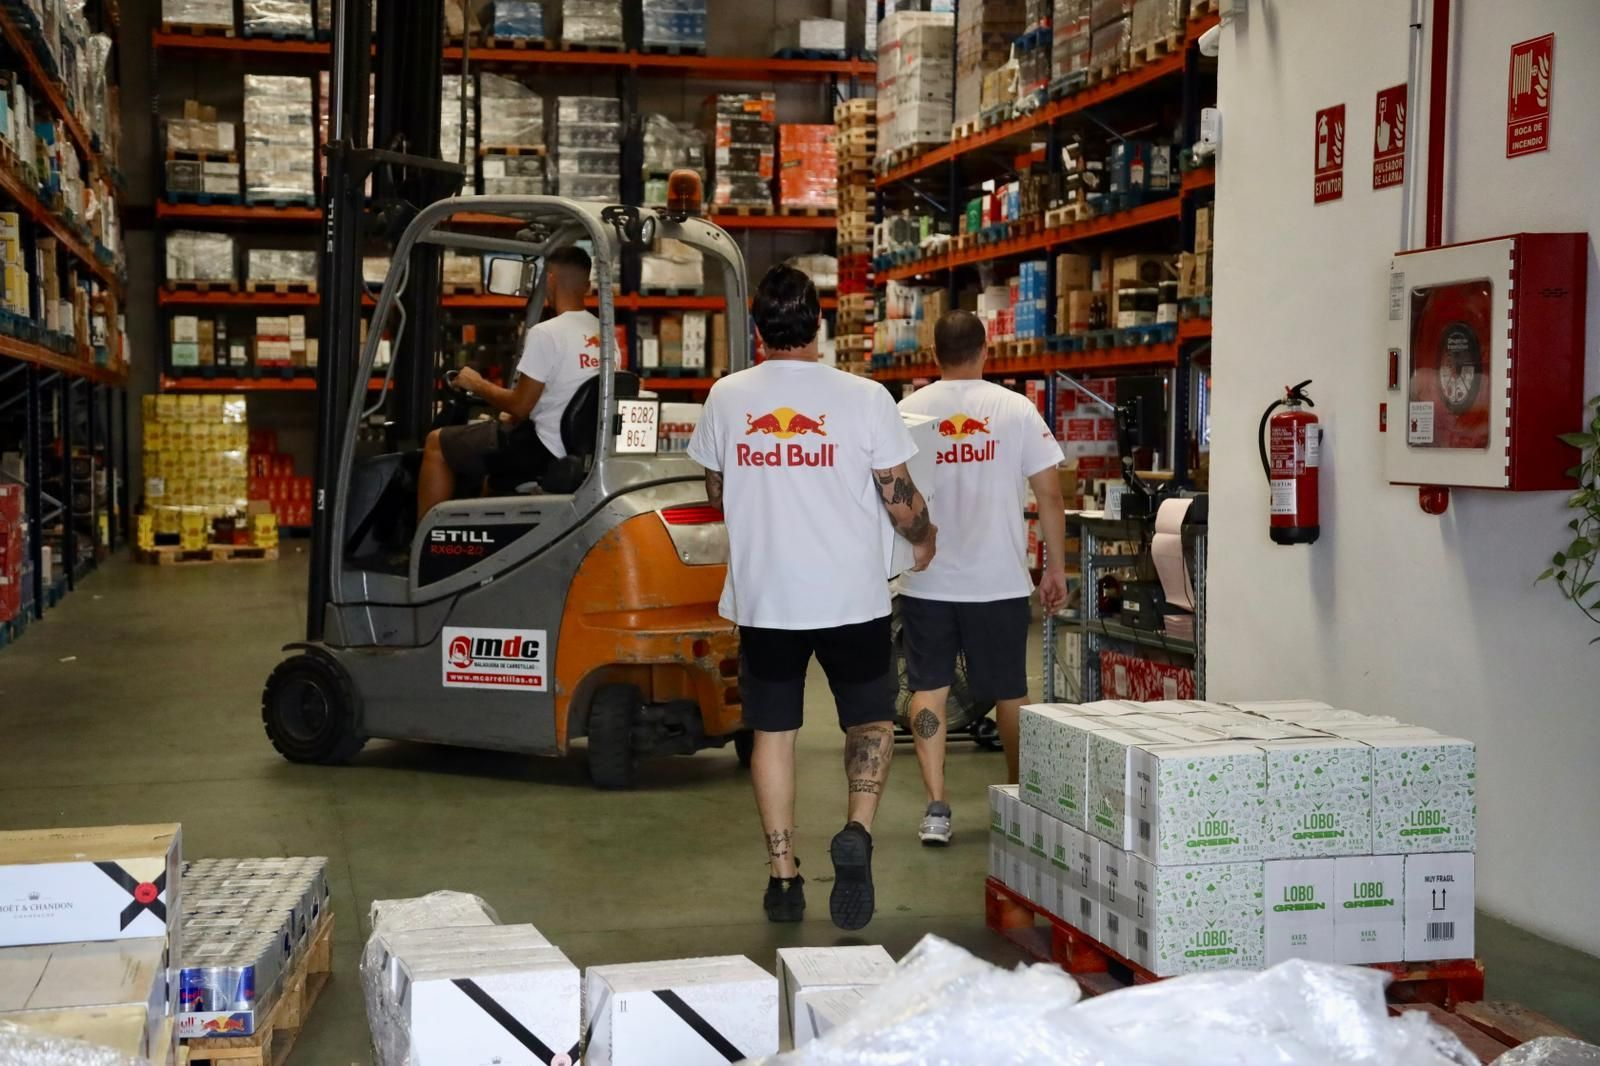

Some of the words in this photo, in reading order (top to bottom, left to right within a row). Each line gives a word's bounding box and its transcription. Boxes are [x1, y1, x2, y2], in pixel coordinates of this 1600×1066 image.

[1514, 125, 1532, 137] BOCA
[1533, 122, 1543, 132] DE
[1512, 135, 1544, 150] INCENDIO
[1374, 158, 1403, 173] PULSADOR
[1374, 175, 1382, 186] DE
[1382, 170, 1403, 184] ALARMA
[1315, 177, 1342, 197] EXTINTOR
[579, 353, 601, 369] Re
[631, 406, 655, 424] 6282
[626, 430, 647, 447] BGZ
[736, 443, 782, 467] Red
[787, 443, 834, 467] Bull
[936, 443, 958, 465] ed
[961, 440, 995, 463] Bull
[431, 529, 496, 543] STILL
[475, 635, 540, 659] mdc
[449, 674, 539, 685] www.mcarretillas.es
[1303, 813, 1334, 830] LOBO
[1411, 809, 1441, 827] LOBO
[1198, 820, 1229, 837] LOBO
[1292, 830, 1345, 840] GREEN
[1400, 826, 1451, 837] GREEN
[1186, 837, 1240, 848] GREEN
[1424, 875, 1435, 883] MUY
[1436, 875, 1455, 883] FRAGIL
[1283, 885, 1314, 902] LOBO
[1353, 881, 1384, 899] LOBO
[22, 904, 28, 912] &
[30, 902, 73, 912] CHANDON
[1273, 902, 1326, 913] GREEN
[1343, 898, 1395, 909] GREEN
[1196, 929, 1227, 947] LOBO
[1184, 947, 1238, 958] GREEN
[180, 1016, 194, 1027] ull
